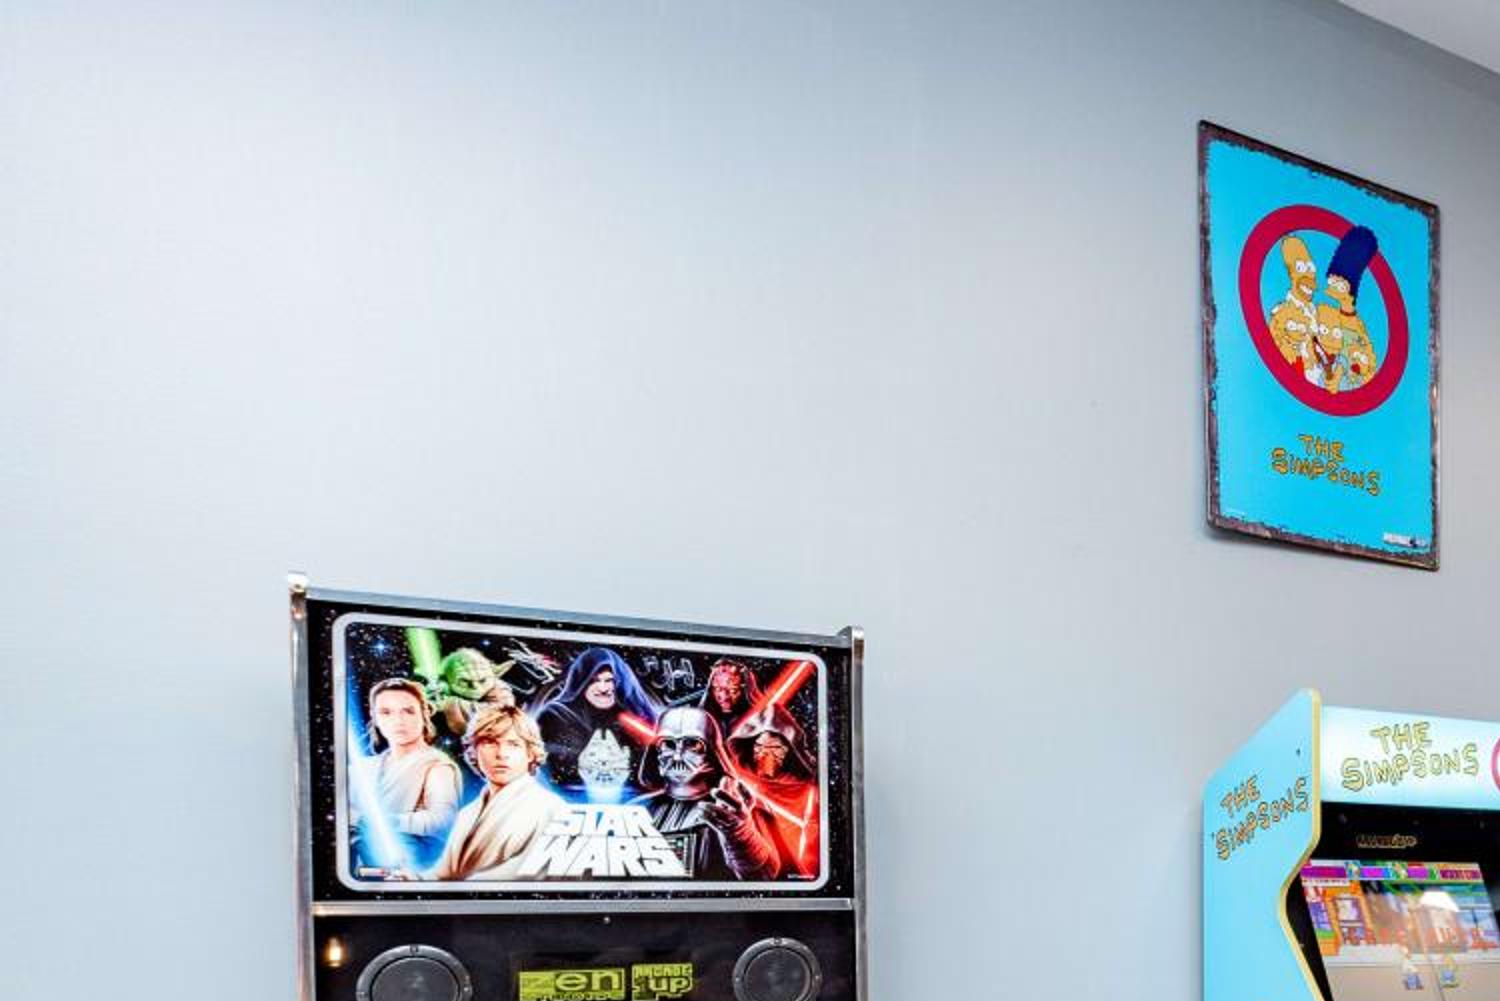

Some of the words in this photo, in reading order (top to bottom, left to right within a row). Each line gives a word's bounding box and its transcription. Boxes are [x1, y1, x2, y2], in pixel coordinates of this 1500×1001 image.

[1297, 433, 1345, 463] THE
[1271, 447, 1380, 496] SIMPSONS
[1369, 721, 1432, 754] THE
[1342, 742, 1479, 792] SIMPSONS
[1220, 775, 1260, 818] THE
[546, 804, 664, 837] STAR
[1215, 777, 1309, 861] SIMPSONS
[514, 834, 692, 878] WARS
